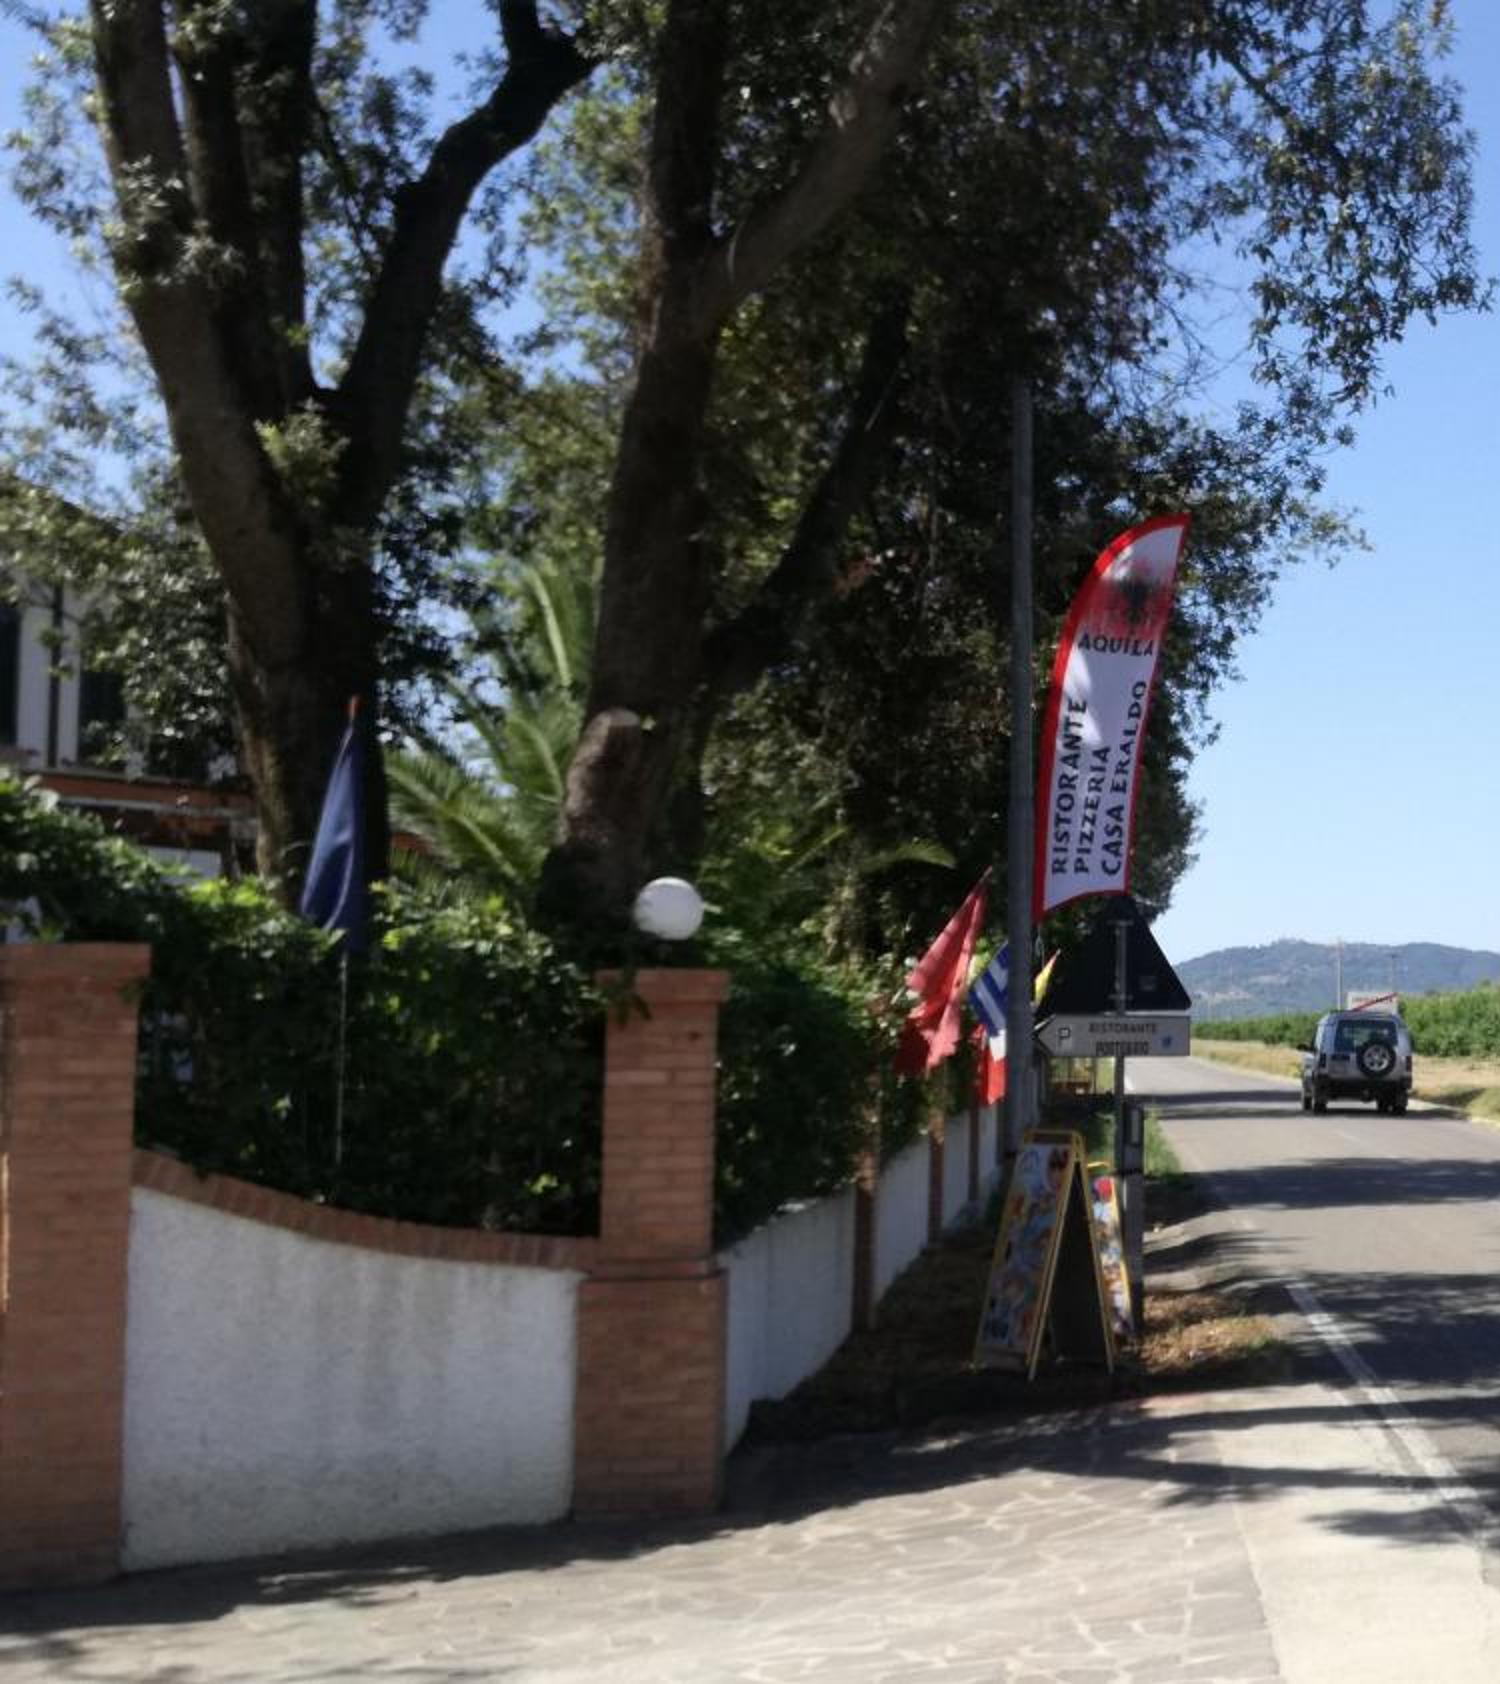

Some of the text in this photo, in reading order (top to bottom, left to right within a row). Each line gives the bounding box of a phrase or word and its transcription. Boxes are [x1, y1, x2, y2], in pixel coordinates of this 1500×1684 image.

[1078, 632, 1154, 657] AQUILA
[1051, 698, 1087, 875] RISTORANTE
[1074, 746, 1111, 875] PIZZERIA
[1101, 680, 1147, 876] CASA ERALDO
